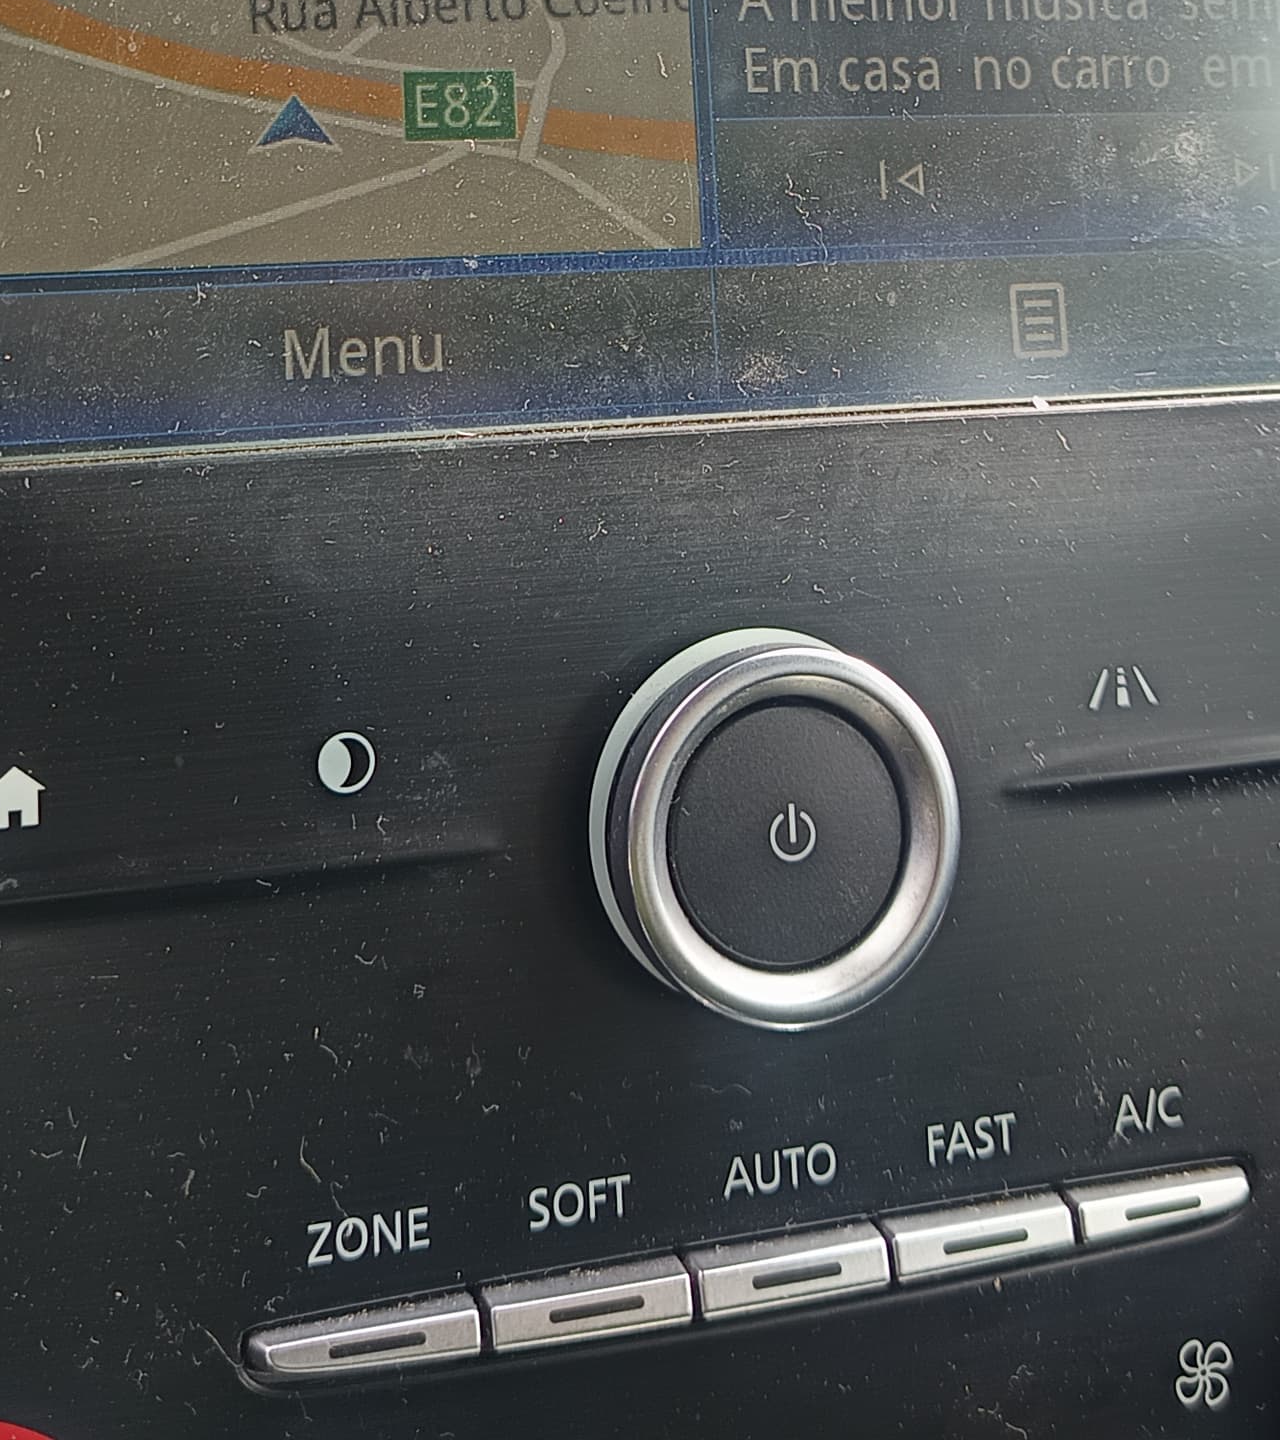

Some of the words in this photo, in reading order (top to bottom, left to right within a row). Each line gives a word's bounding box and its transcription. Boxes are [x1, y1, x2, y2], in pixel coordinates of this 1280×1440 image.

[744, 47, 820, 94] Em
[838, 56, 942, 93] casa
[972, 54, 1031, 91] no
[1050, 54, 1171, 90] carro
[1202, 54, 1272, 88] em
[415, 83, 503, 129] E82
[282, 326, 445, 381] Menu
[1114, 1085, 1183, 1137] A/C
[925, 1112, 1017, 1166] FAST
[723, 1143, 838, 1202] AUTO
[528, 1174, 632, 1232] SOFT
[307, 1206, 431, 1268] ZONE
